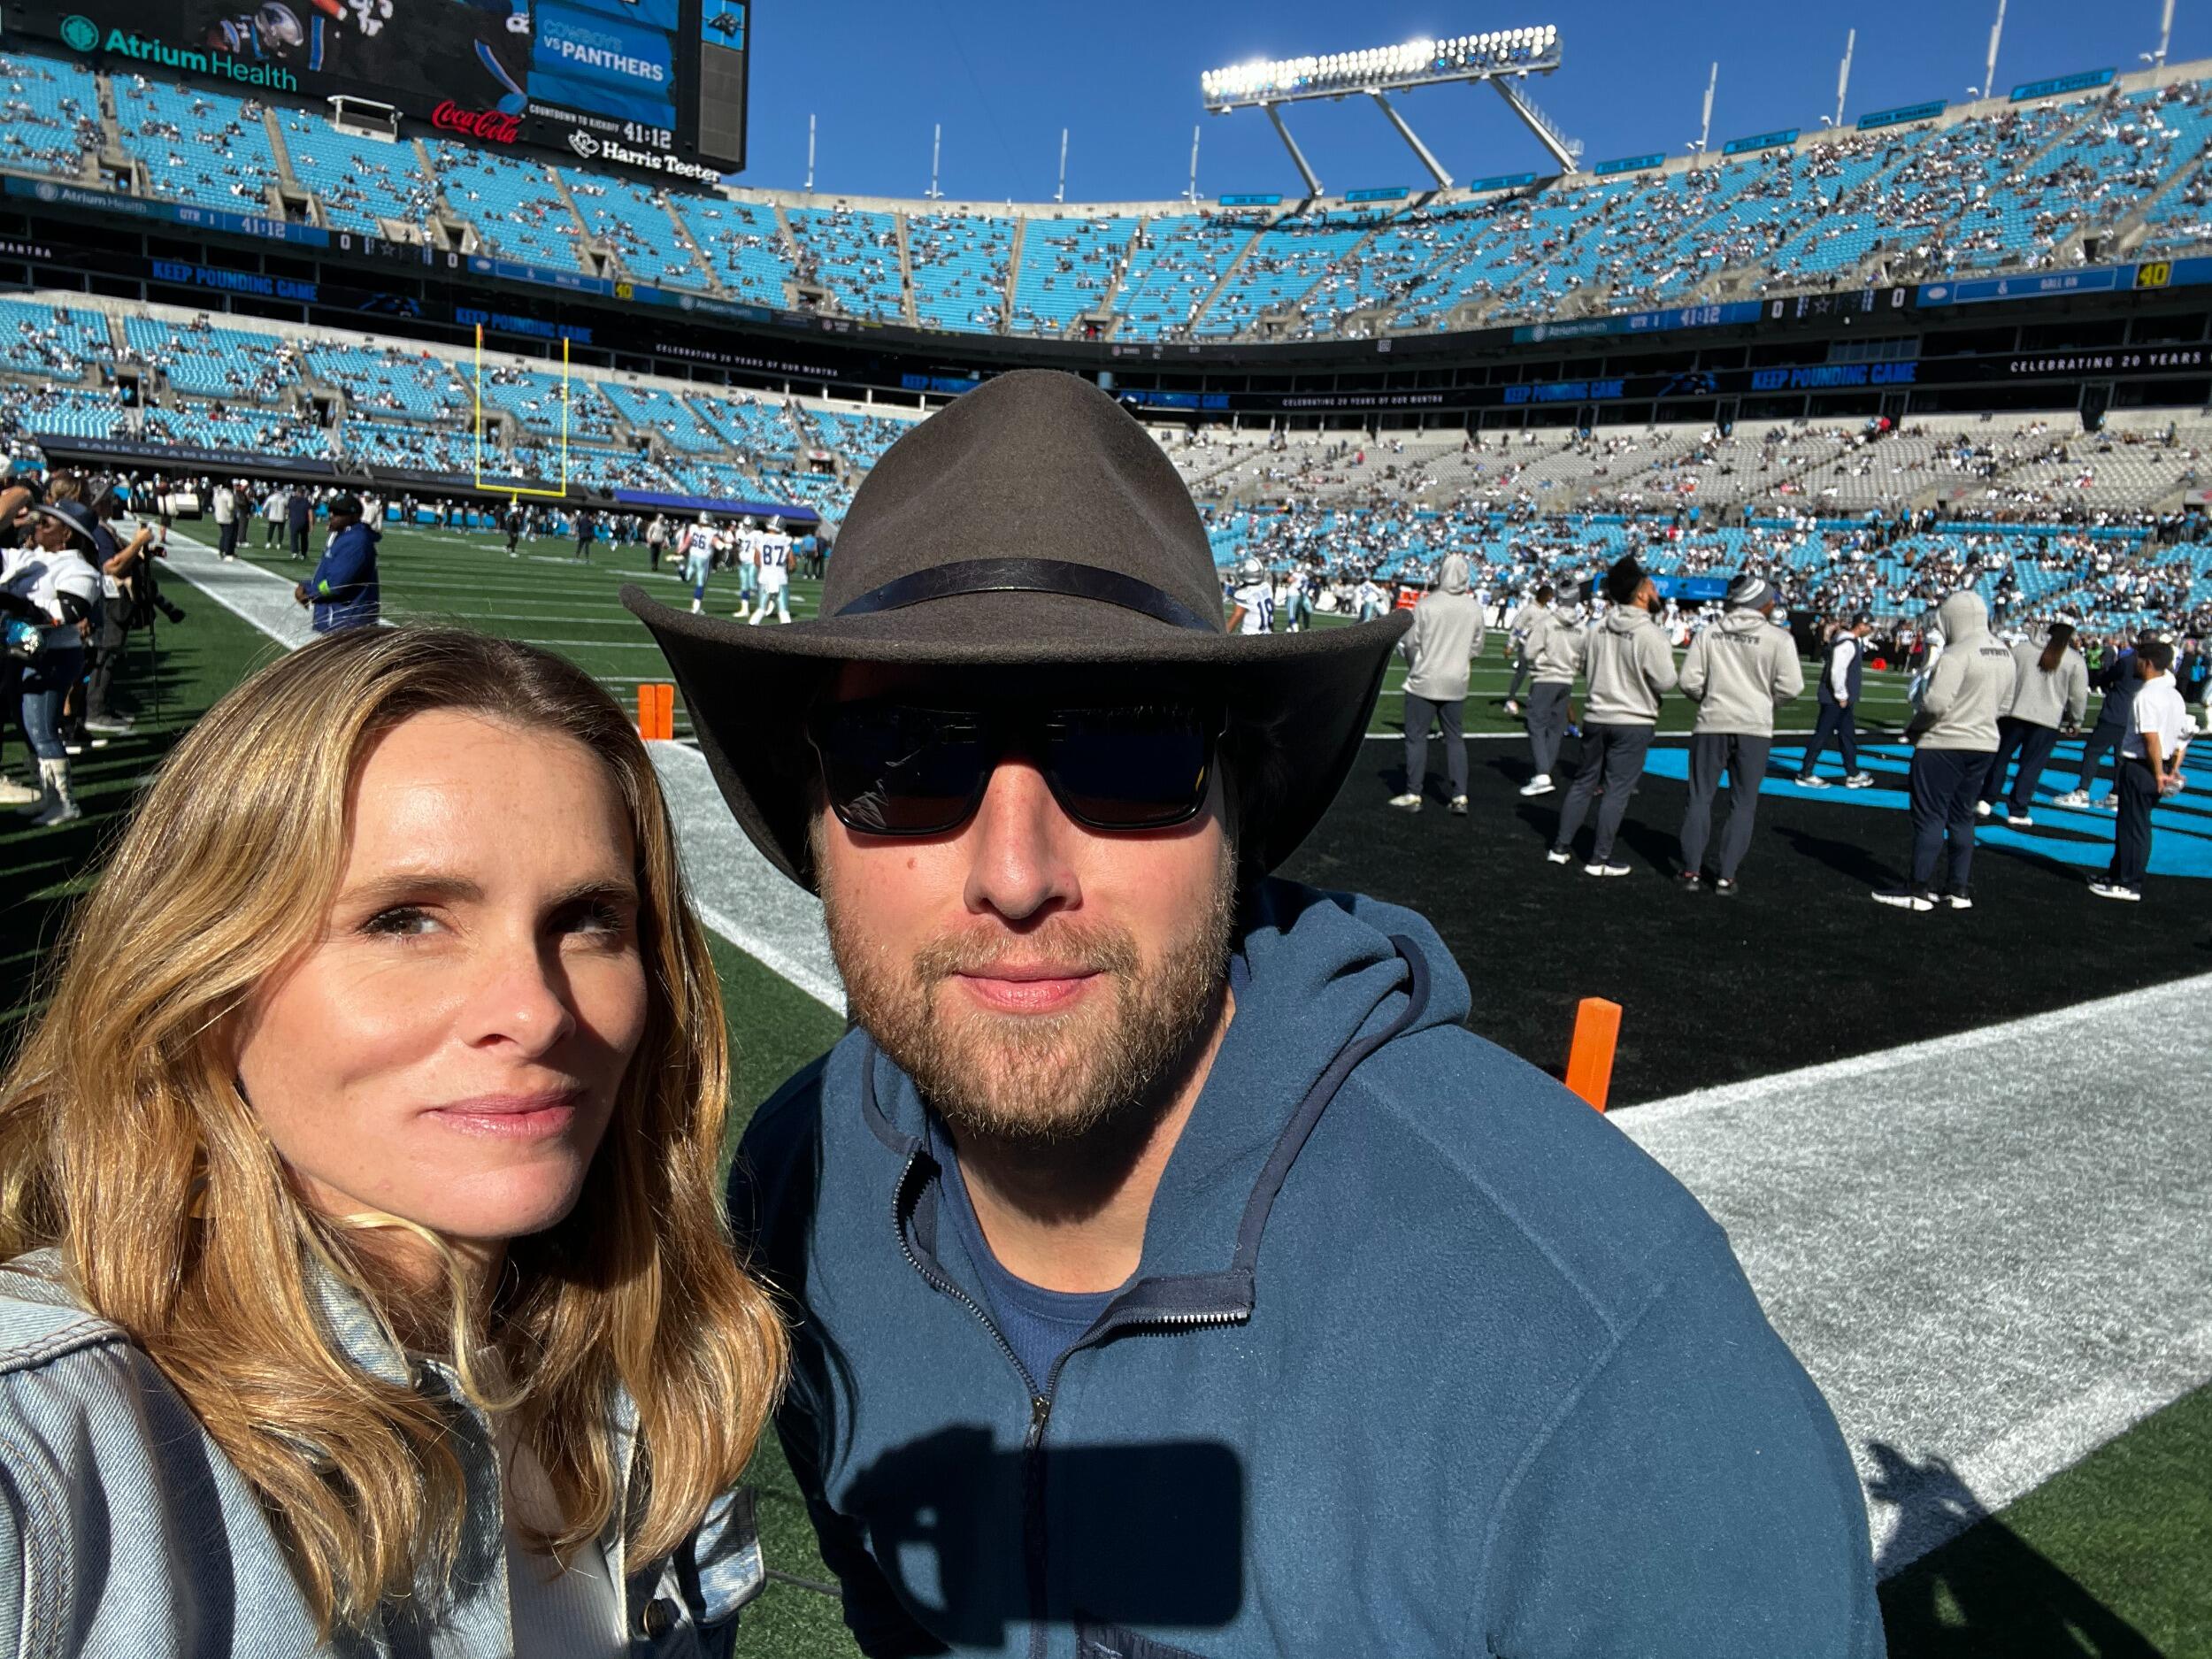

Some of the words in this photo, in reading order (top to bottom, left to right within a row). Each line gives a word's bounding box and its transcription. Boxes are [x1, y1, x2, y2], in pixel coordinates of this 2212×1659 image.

[105, 29, 207, 72] Atrium
[211, 51, 297, 91] Health
[562, 41, 664, 81] PANTHERS
[432, 100, 522, 143] Coca-Cola
[624, 122, 672, 150] 41:12
[602, 140, 662, 169] Harris
[664, 155, 720, 181] Teeter
[242, 217, 286, 239] 41:12
[152, 259, 192, 282] KEEP
[196, 267, 273, 295] POUNDING
[276, 279, 319, 303] GAME
[2139, 263, 2168, 287] 40
[1681, 306, 1721, 326] 41:12
[656, 343, 717, 361] CELEBRATING
[2010, 356, 2114, 373] CELEBRATING
[2122, 355, 2140, 367] 20
[2149, 352, 2201, 366] YEARS
[1752, 368, 1789, 390] KEEP
[1790, 364, 1869, 388] POUNDING
[1870, 361, 1918, 384] GAME
[78, 442, 132, 453] BANK
[138, 446, 163, 456] OF
[168, 449, 253, 463] AMERICA
[763, 544, 785, 566] 87
